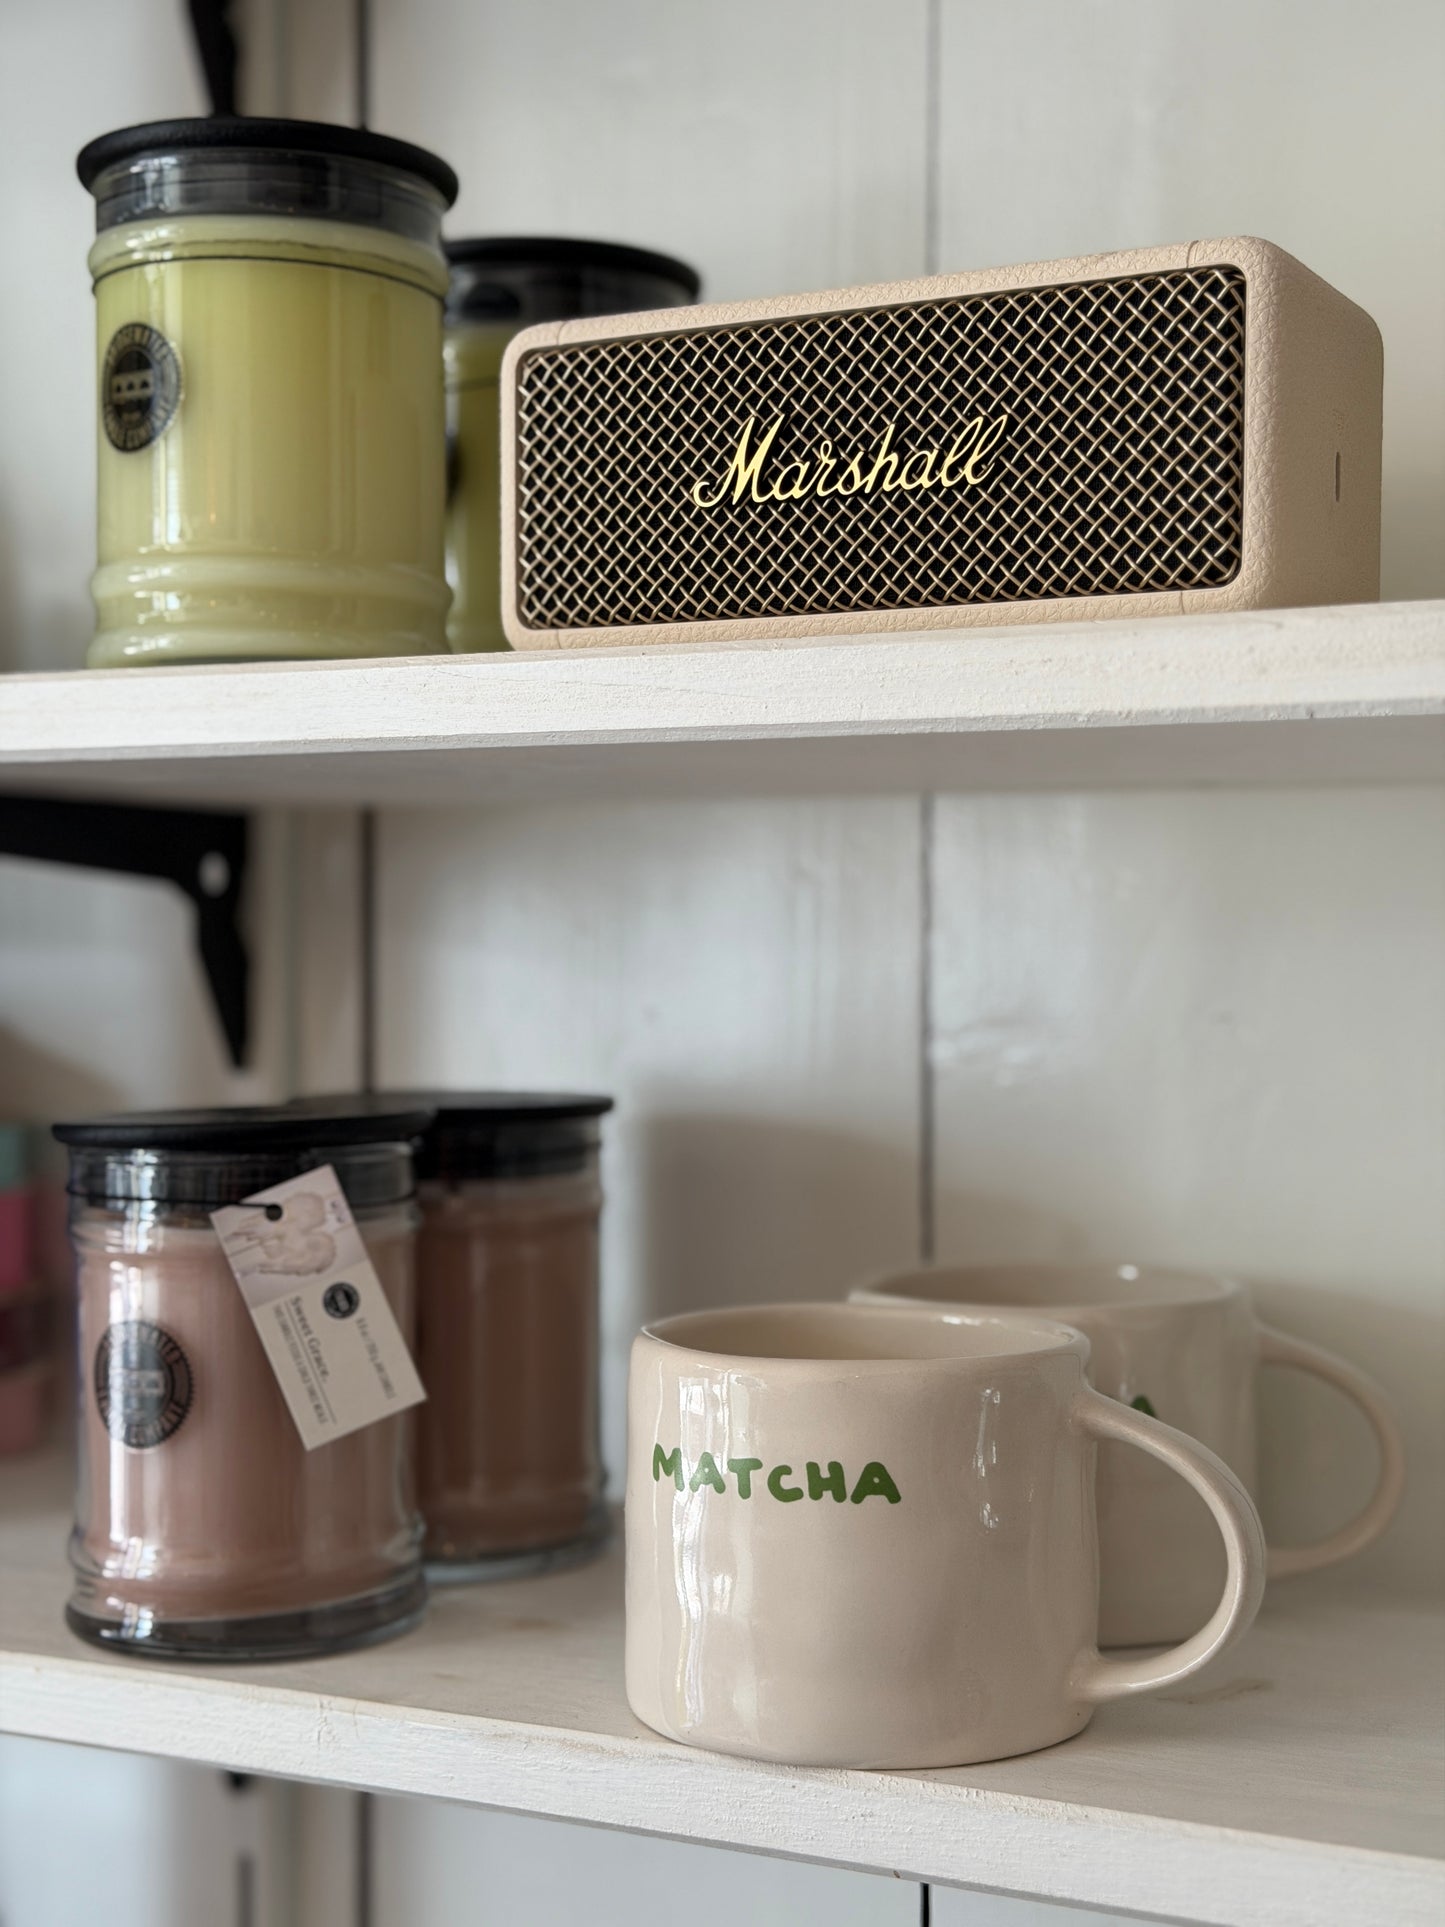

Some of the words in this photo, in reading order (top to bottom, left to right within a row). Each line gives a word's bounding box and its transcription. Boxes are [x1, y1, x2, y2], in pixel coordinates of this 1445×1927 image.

[693, 414, 1008, 507] Marshall
[291, 1296, 313, 1337] Sweet
[652, 1443, 902, 1505] MATCHA
